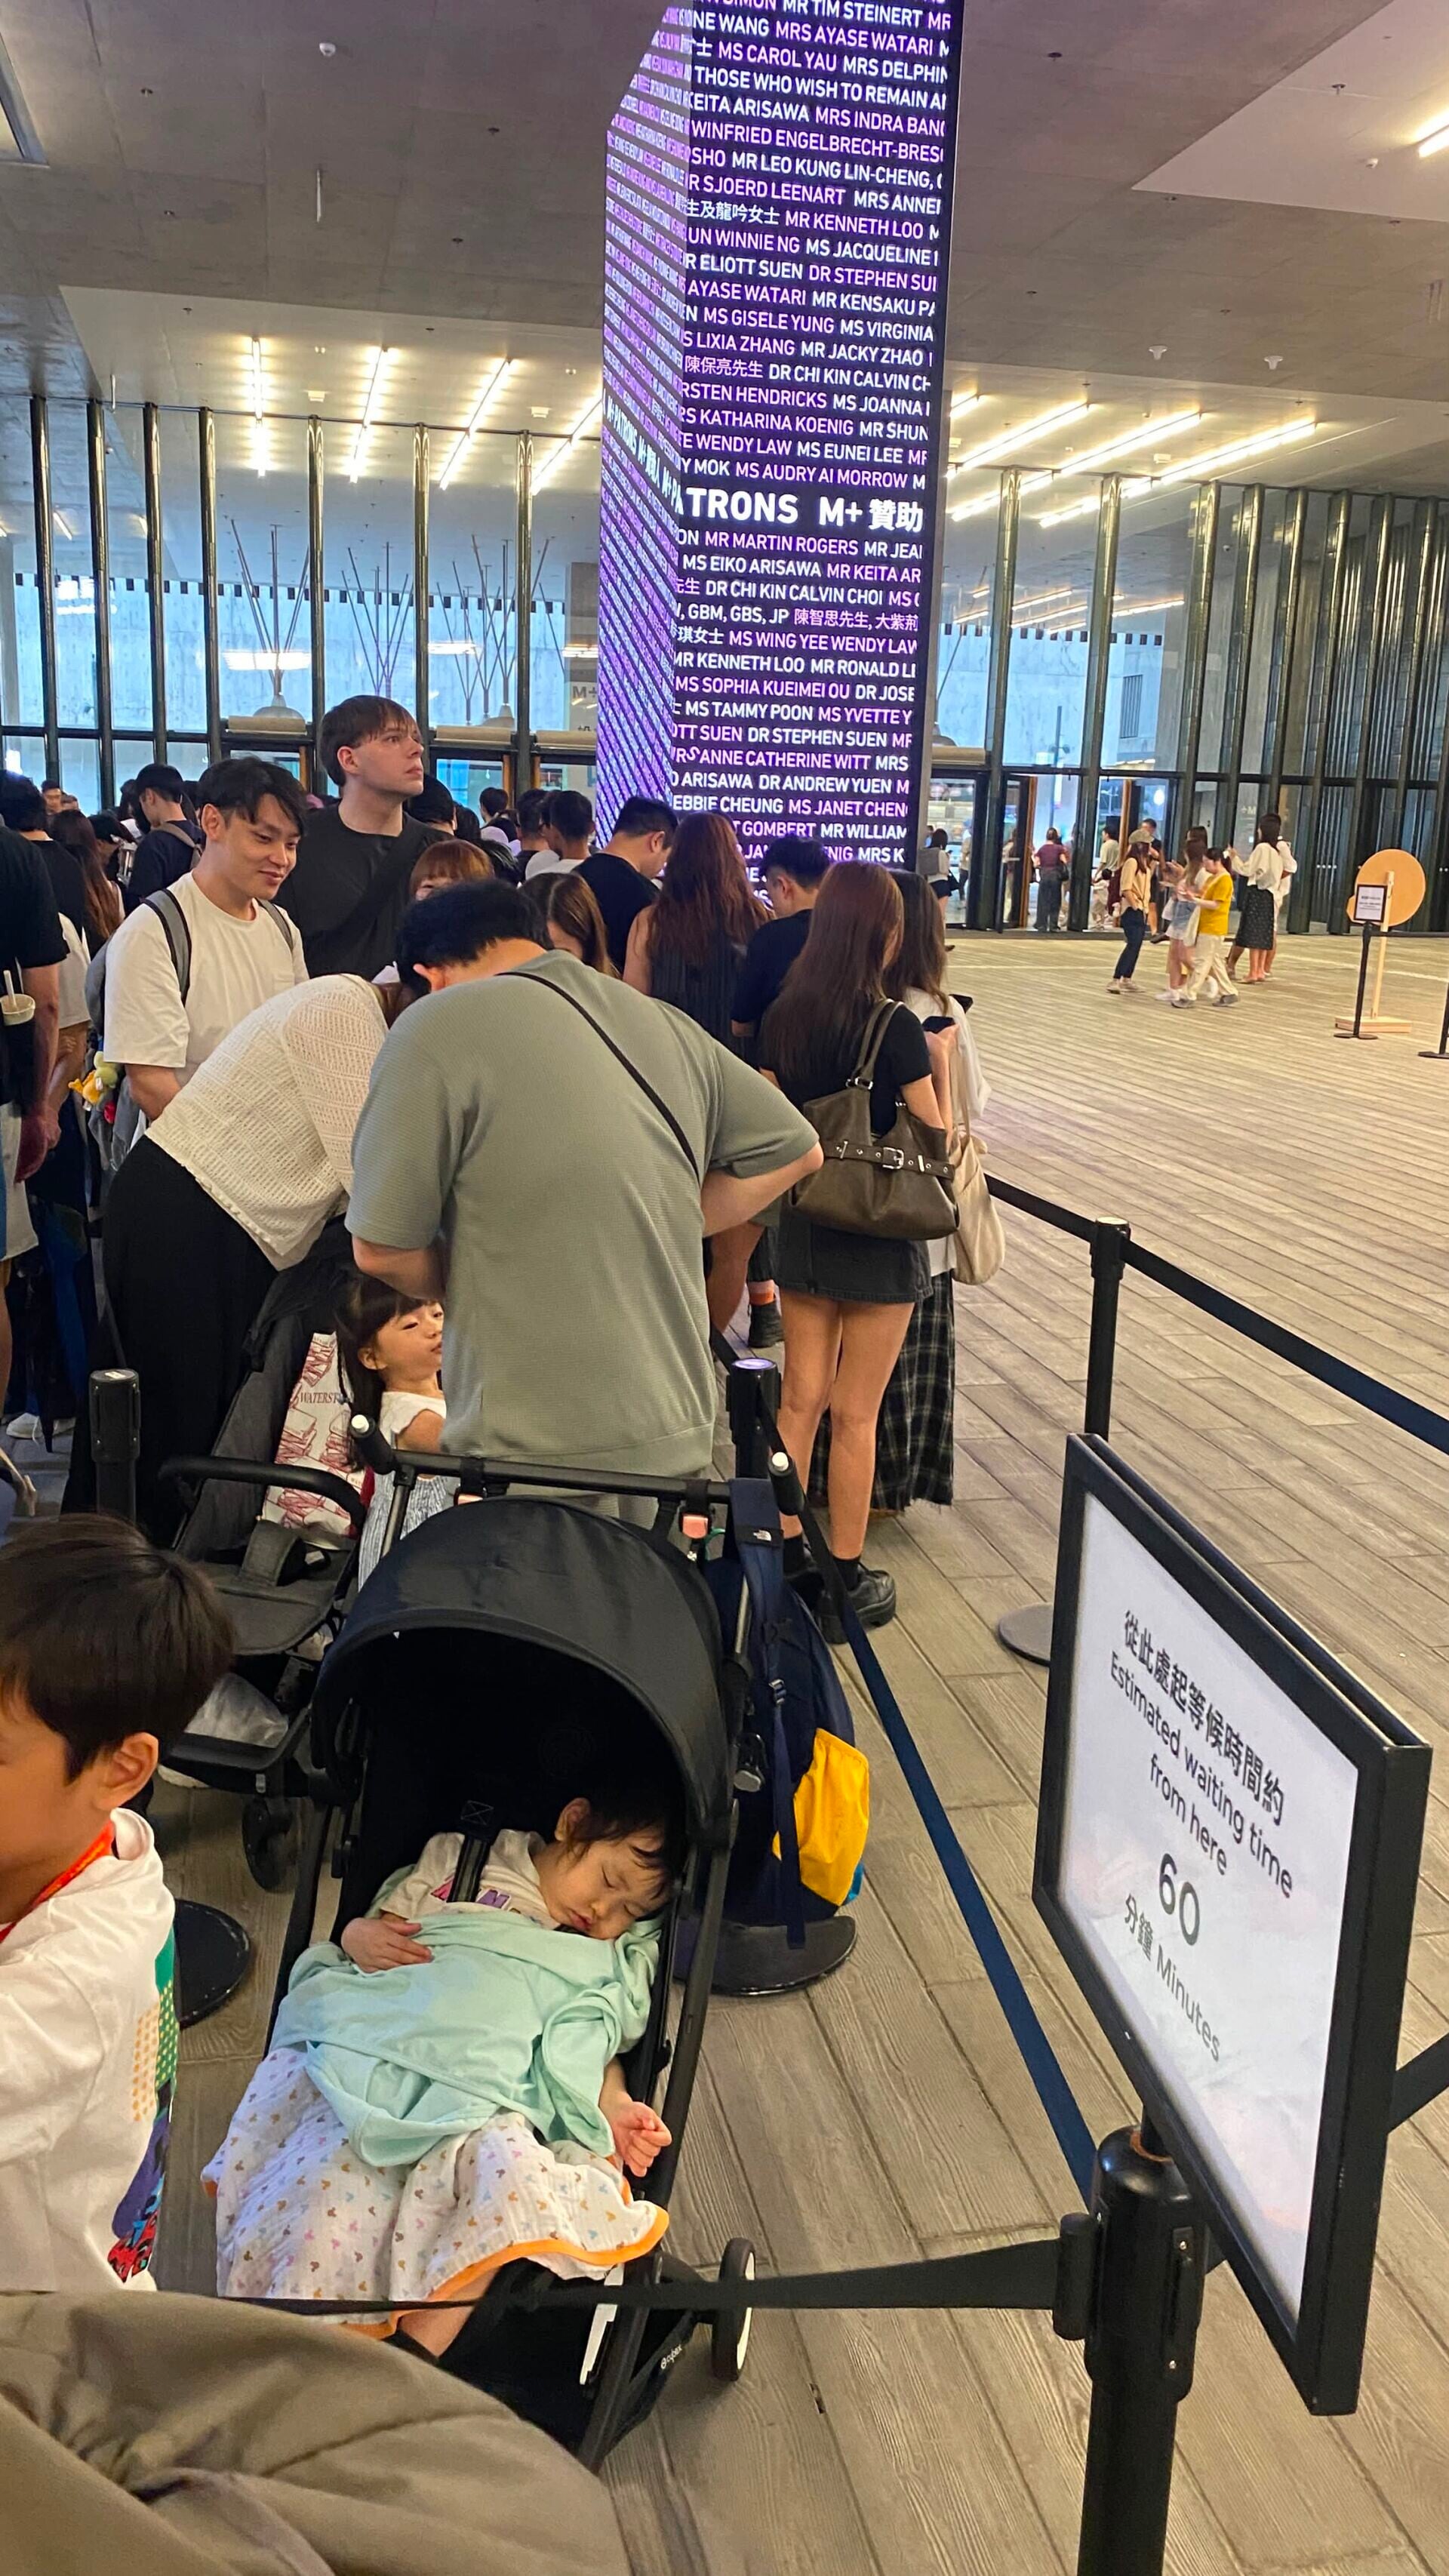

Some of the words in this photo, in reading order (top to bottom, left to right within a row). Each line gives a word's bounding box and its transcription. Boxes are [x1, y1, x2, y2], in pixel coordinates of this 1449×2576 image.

[811, 0, 840, 17] TIM
[842, 1, 923, 28] STEINERT
[718, 13, 769, 36] WANG
[776, 20, 811, 42] MRS
[814, 25, 868, 48] AYASE
[871, 32, 933, 56] WATARI
[718, 41, 743, 60] MS
[746, 45, 801, 67] CAROL
[804, 51, 836, 71] YAU
[843, 54, 878, 76] MRS
[694, 65, 750, 88] THOSE
[753, 72, 792, 93] WHO
[795, 76, 838, 98] WISH
[840, 82, 862, 101] TO
[865, 85, 928, 108] REMAIN
[733, 97, 809, 122] ARISAWA
[815, 106, 850, 127] MRS
[854, 110, 903, 132] INDRA
[691, 119, 771, 144] WINFRIED
[732, 151, 757, 170] MR
[761, 154, 792, 174] LEO
[795, 158, 841, 178] KUNG
[844, 162, 933, 189] LIN-CHENG,
[703, 174, 768, 197] SJOERD
[771, 182, 846, 205] LEENART
[854, 189, 889, 210] MRS
[785, 210, 810, 228] MR
[813, 212, 889, 235] KENNETH
[892, 220, 923, 239] LOO
[715, 229, 774, 251] WINNIE
[777, 235, 799, 253] NG
[806, 238, 830, 256] MS
[832, 241, 931, 265] JACQUELINE
[700, 254, 756, 275] ELIOTT
[758, 259, 802, 279] SUEN
[809, 264, 830, 282] DR
[834, 266, 908, 288] STEPHEN
[688, 279, 741, 299] AYASE
[744, 285, 805, 305] WATARI
[812, 291, 836, 308] MR
[840, 293, 915, 315] KENSAKU
[703, 306, 728, 324] MS
[731, 309, 788, 329] GISELE
[791, 314, 834, 333] YUNG
[840, 319, 863, 336] MS
[866, 321, 933, 341] VIRGINIA
[697, 331, 737, 350] LIXIA
[740, 335, 795, 355] ZHANG
[801, 340, 825, 358] MR
[828, 343, 879, 362] JACKY
[880, 347, 923, 366] ZHAO
[768, 363, 791, 380] DR
[794, 365, 820, 382] CHI
[823, 368, 851, 385] KIN
[853, 370, 909, 389] CALVIN
[736, 386, 826, 408] HENDRICKS
[832, 393, 856, 411] MS
[859, 396, 922, 416] JOANNA
[700, 408, 792, 430] KATHARINA
[795, 416, 853, 435] KOENIG
[859, 420, 884, 438] MR
[696, 433, 753, 452] WENDY
[756, 438, 792, 455] LAW
[797, 441, 820, 457] MS
[823, 442, 870, 461] EUNEI
[873, 446, 903, 463] LEE
[694, 458, 730, 475] MOK
[735, 461, 758, 478] MS
[761, 463, 816, 482] AUDRY
[818, 467, 833, 483] AI
[837, 468, 907, 488] MORROW
[819, 496, 863, 526] M+
[705, 531, 729, 547] MR
[733, 532, 792, 550] MARTIN
[795, 536, 858, 556] ROGERS
[863, 540, 888, 557] MR
[682, 554, 706, 571] MS
[709, 556, 746, 573] EIKO
[749, 559, 821, 577] ARISAWA
[826, 563, 850, 579] MR
[854, 565, 897, 581] KEITA
[706, 580, 728, 596] DR
[730, 579, 756, 598] CHI
[759, 583, 786, 599] KIN
[789, 584, 844, 602] CALVIN
[847, 588, 882, 605] CHOI
[888, 590, 911, 606] MS
[688, 603, 727, 622] GBM,
[730, 605, 766, 624] GBS,
[768, 608, 789, 623] JP
[729, 630, 752, 646] MS
[755, 631, 796, 648] WING
[799, 633, 828, 650] YEE
[830, 636, 885, 653] WENDY
[697, 652, 771, 670] KENNETH
[774, 656, 804, 672] LOO
[811, 658, 834, 674] MR
[837, 659, 899, 677] RONALD
[675, 676, 699, 692] MS
[702, 676, 759, 694] SOPHIA
[763, 680, 825, 697] KUEIMEI
[828, 682, 850, 699] OU
[855, 684, 876, 700] DR
[685, 700, 709, 716] MS
[711, 701, 768, 719] TAMMY
[770, 703, 813, 720] POON
[818, 706, 841, 722] MS
[844, 706, 900, 724] YVETTE
[700, 725, 742, 741] SUEN
[748, 727, 769, 743] DR
[771, 727, 843, 745] STEPHEN
[845, 730, 887, 746] SUEN
[699, 749, 743, 765] ANNE
[745, 750, 831, 768] CATHERINE
[833, 753, 871, 770] WITT
[875, 755, 909, 771] MRS
[681, 771, 752, 789] ARISAWA
[758, 774, 780, 789] DR
[782, 775, 849, 792] ANDREW
[851, 777, 891, 793] YUEN
[719, 796, 783, 814] CHEUNG
[789, 799, 811, 814] MS
[814, 800, 863, 815] JANET
[742, 820, 816, 837] GOMBERT
[820, 823, 844, 838] MR
[857, 846, 891, 864] MRS
[1111, 1651, 1180, 1758] Estimated
[1185, 1746, 1244, 1844] waiting
[1250, 1822, 1292, 1898] time
[1151, 1753, 1186, 1823] from
[1191, 1802, 1226, 1875] here
[1159, 1853, 1200, 1946] 60
[1124, 1893, 1153, 1961] 分鐘
[1156, 1944, 1220, 2062] Minutes
